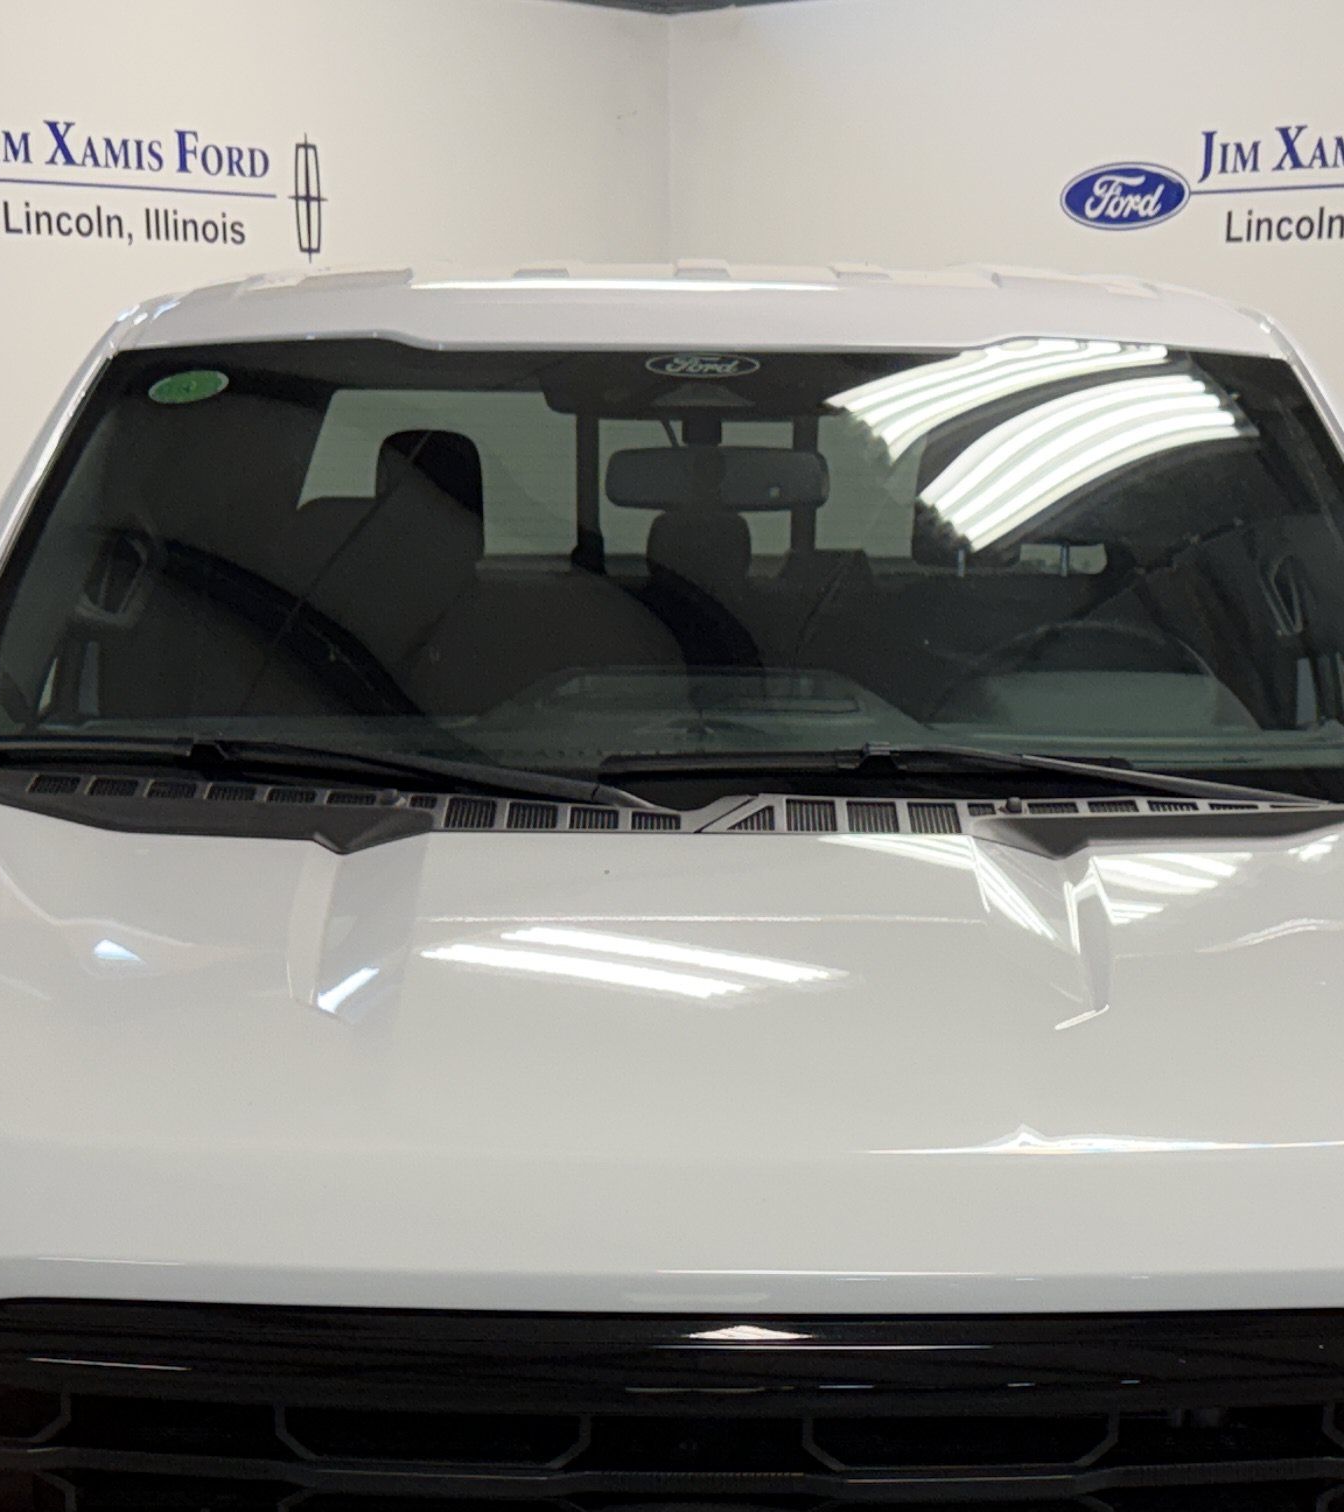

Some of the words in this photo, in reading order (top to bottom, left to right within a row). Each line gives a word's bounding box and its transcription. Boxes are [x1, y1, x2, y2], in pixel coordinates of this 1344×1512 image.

[44, 120, 163, 173] XAMIS
[174, 130, 269, 177] FORD
[1198, 130, 1259, 182] JIM
[1085, 175, 1161, 218] Ford
[3, 201, 134, 245] Lincoln,
[145, 208, 246, 245] Illinois
[665, 357, 739, 372] Ford
